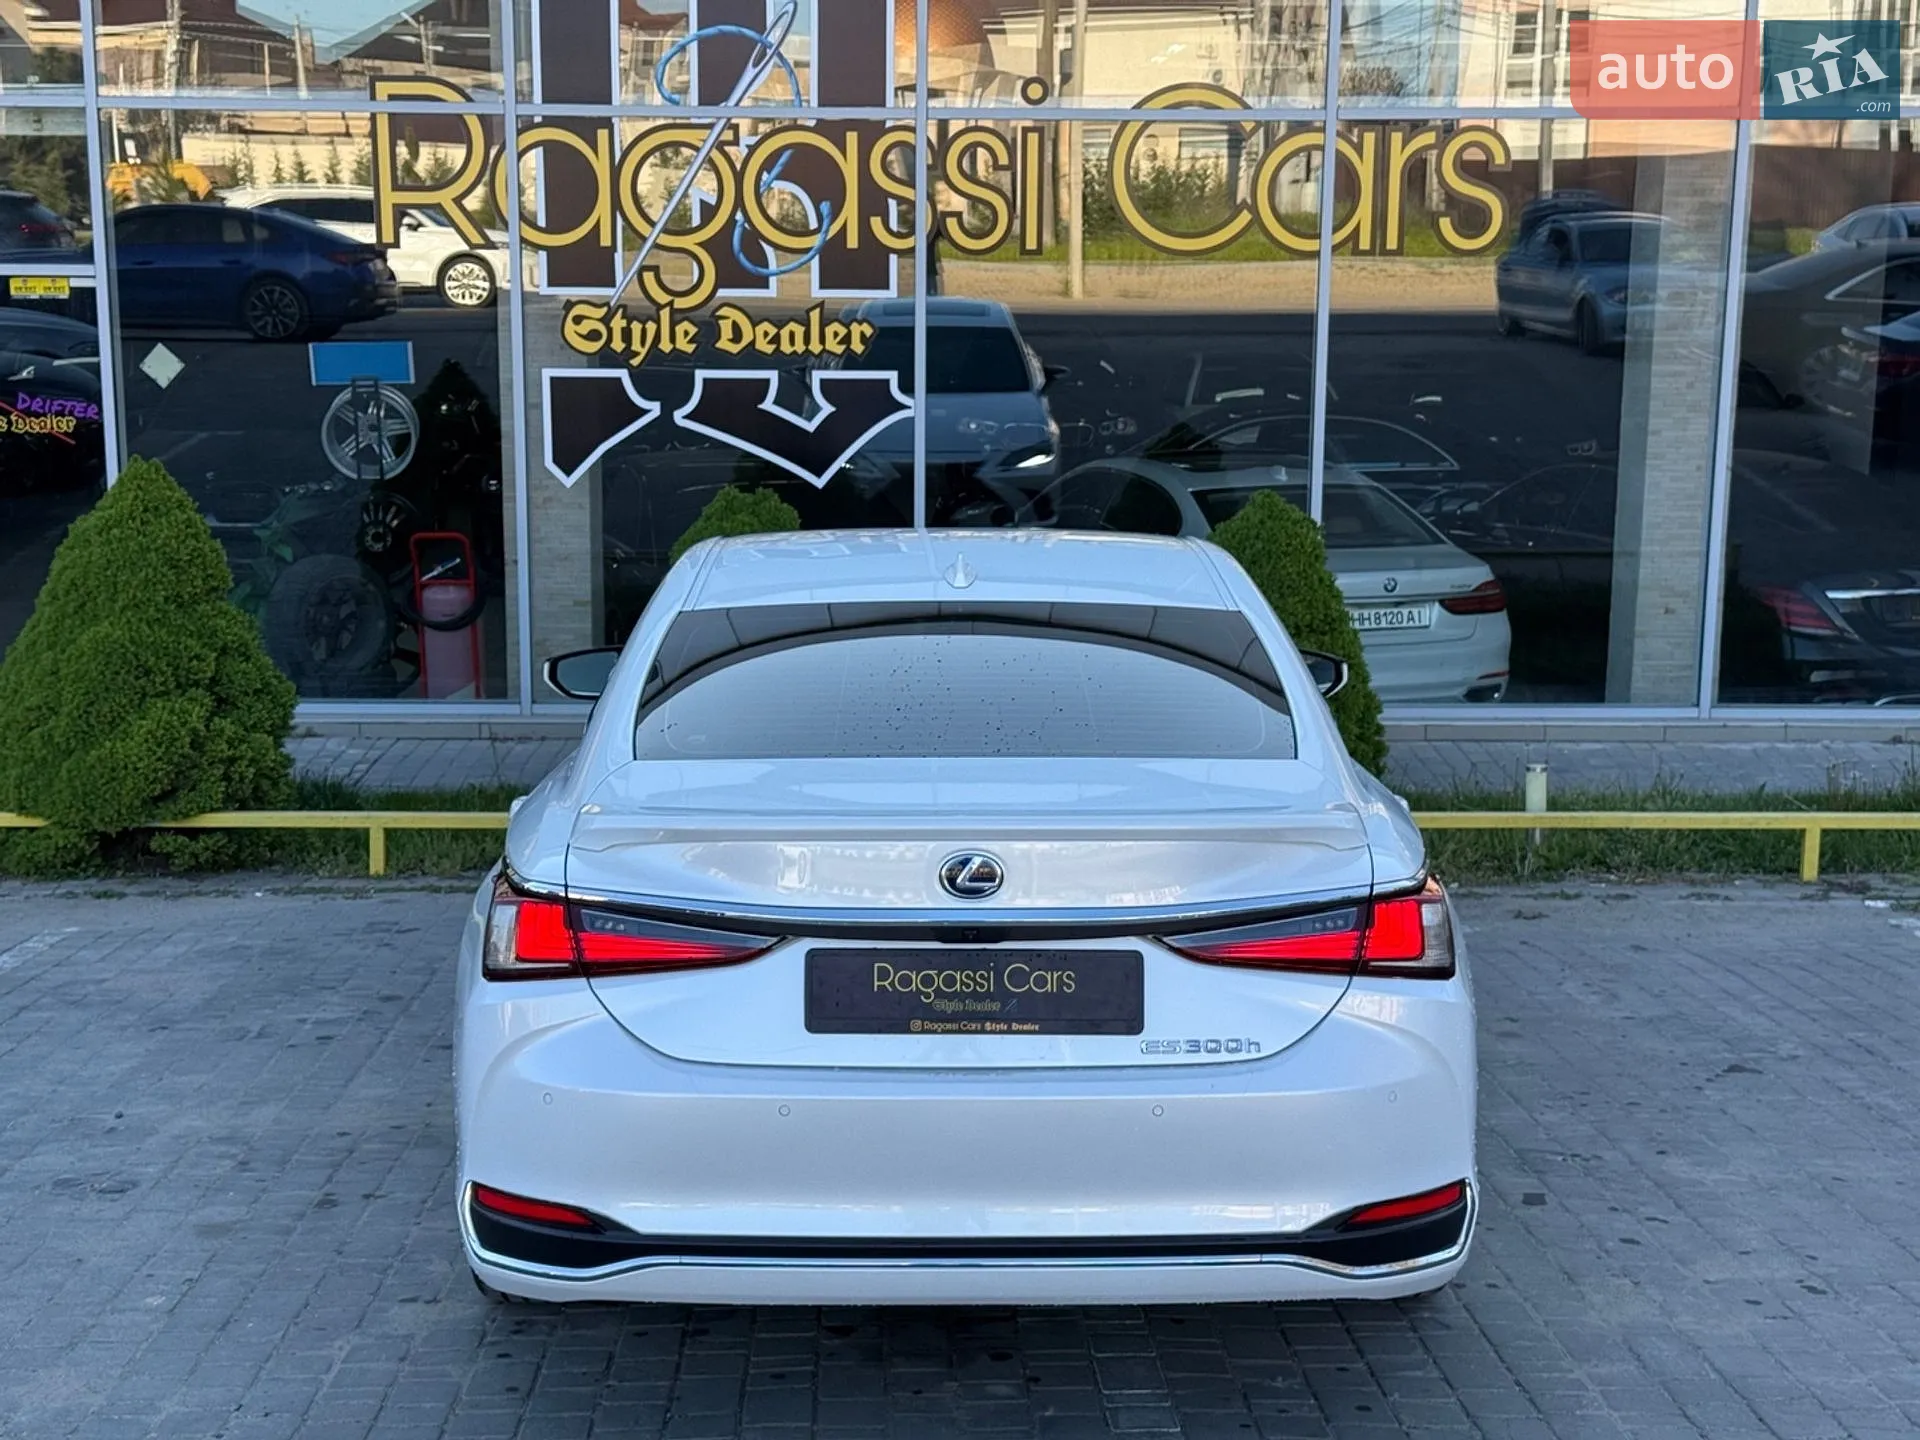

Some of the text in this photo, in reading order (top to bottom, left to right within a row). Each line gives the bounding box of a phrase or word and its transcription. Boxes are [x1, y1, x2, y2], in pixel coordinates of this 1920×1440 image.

[370, 76, 1512, 309] Ragassi Cars
[561, 300, 876, 368] Style Dealer
[10, 411, 76, 433] Dealer
[873, 962, 1076, 1003] Ragassi Cars
[960, 1020, 981, 1031] Cars
